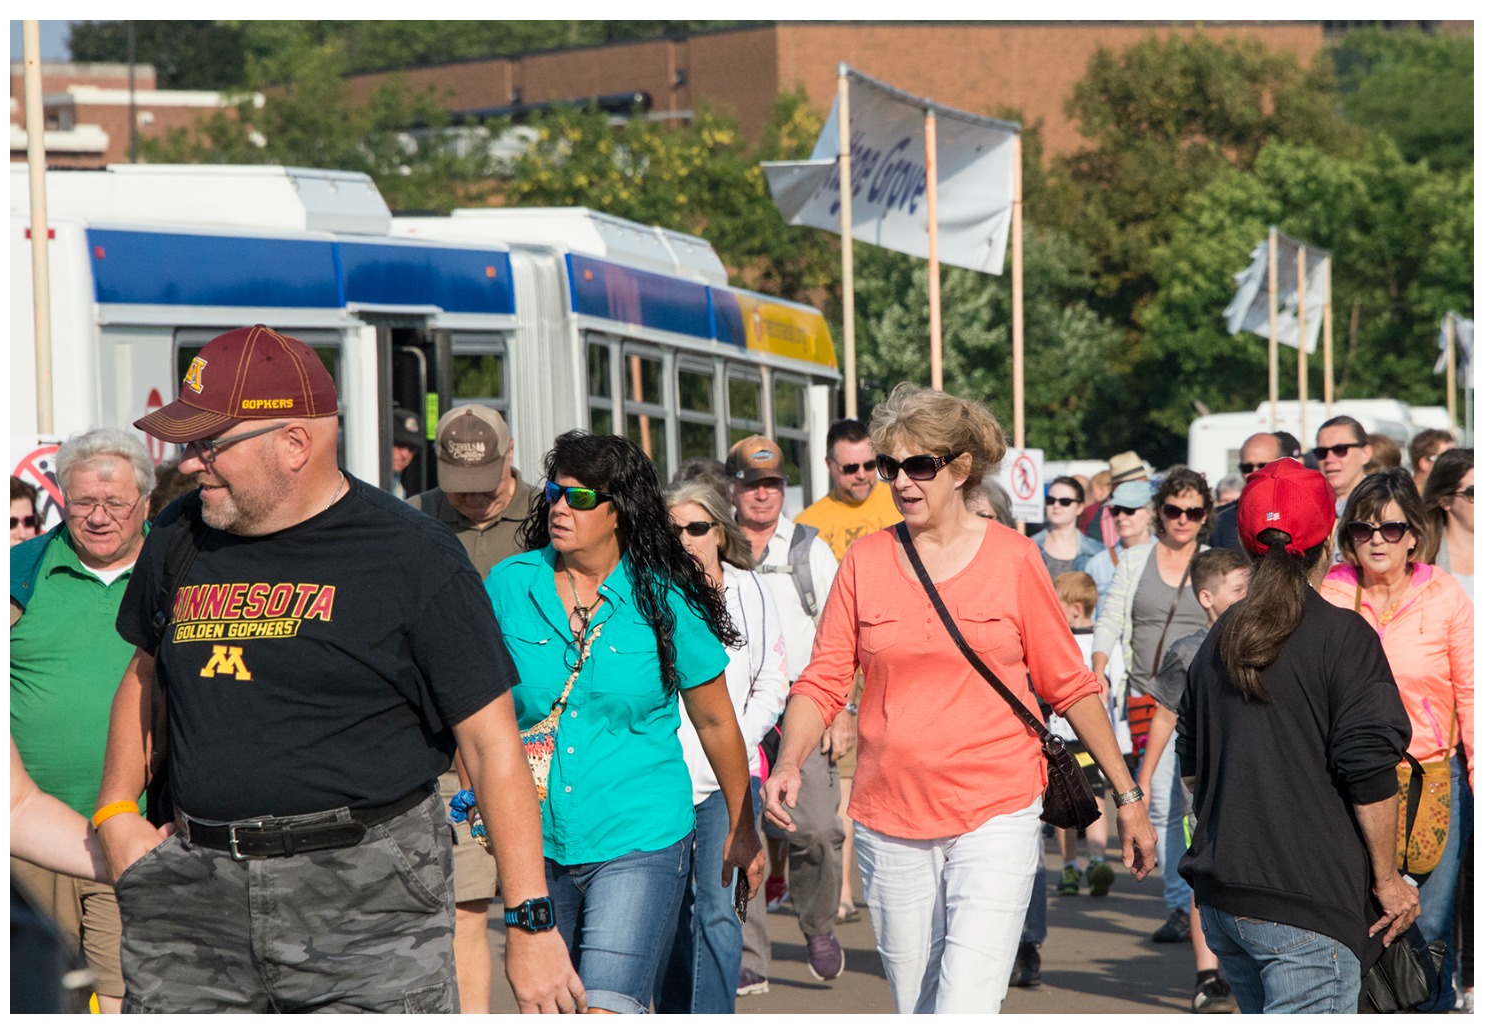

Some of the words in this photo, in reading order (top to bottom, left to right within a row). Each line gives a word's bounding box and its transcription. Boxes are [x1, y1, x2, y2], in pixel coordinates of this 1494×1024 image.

[241, 398, 295, 410] GOPHERS
[176, 623, 225, 640] GOLDEN
[227, 620, 296, 637] GOPHERS
[199, 644, 252, 682] M
